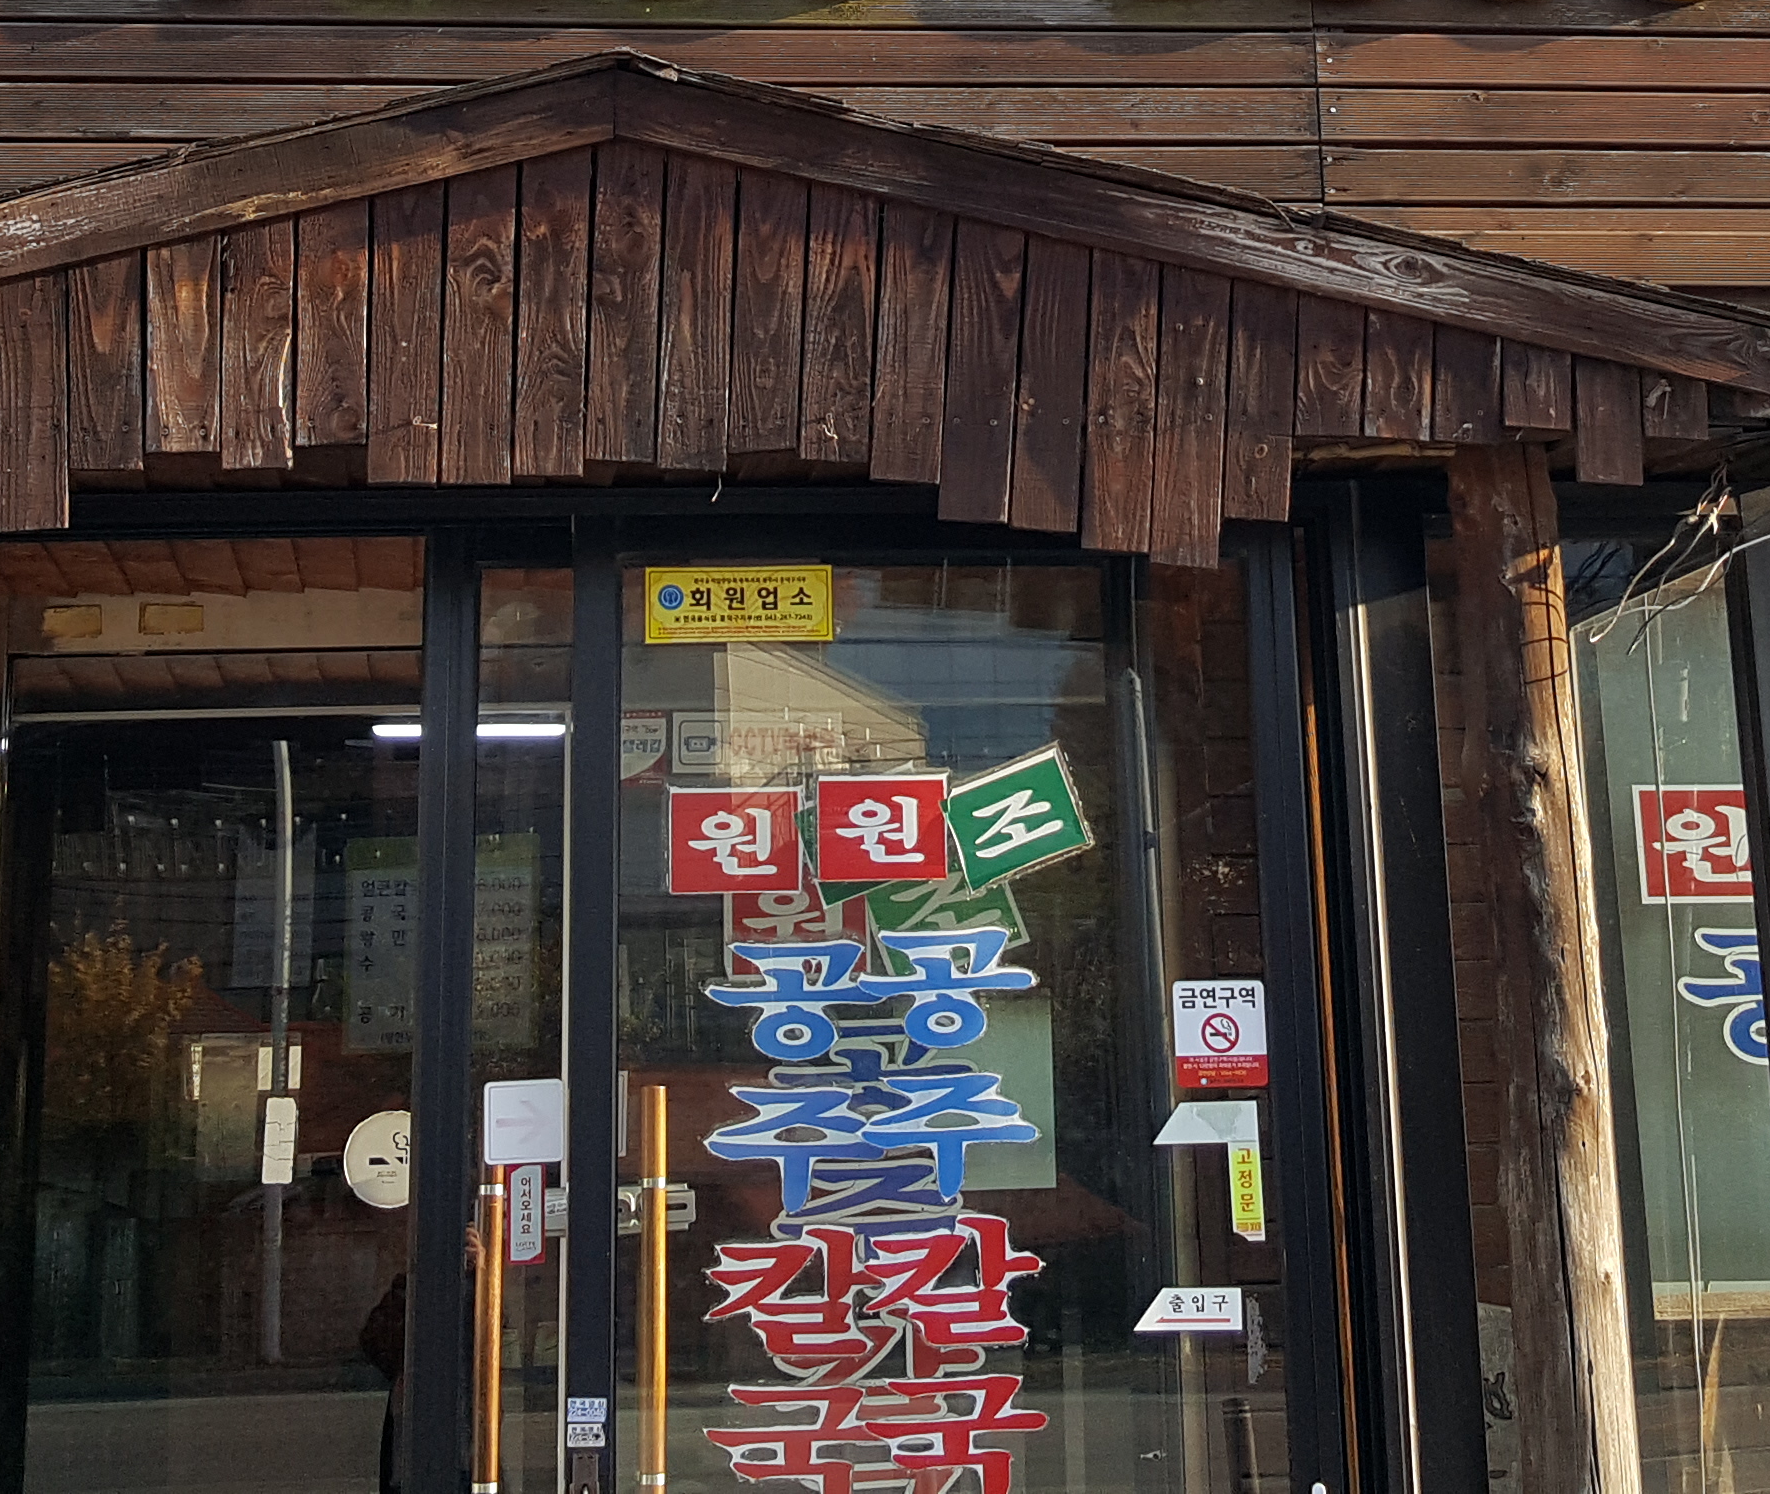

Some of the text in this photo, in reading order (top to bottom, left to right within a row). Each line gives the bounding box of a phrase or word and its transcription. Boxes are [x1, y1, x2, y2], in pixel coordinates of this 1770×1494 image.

[688, 586, 814, 612] 회원업소
[834, 788, 1064, 864] 원조
[1178, 986, 1256, 1009] 금연구역
[1236, 1147, 1255, 1213] 고정문
[520, 1176, 533, 1235] 어서오세요
[1168, 1293, 1230, 1314] 출입구
